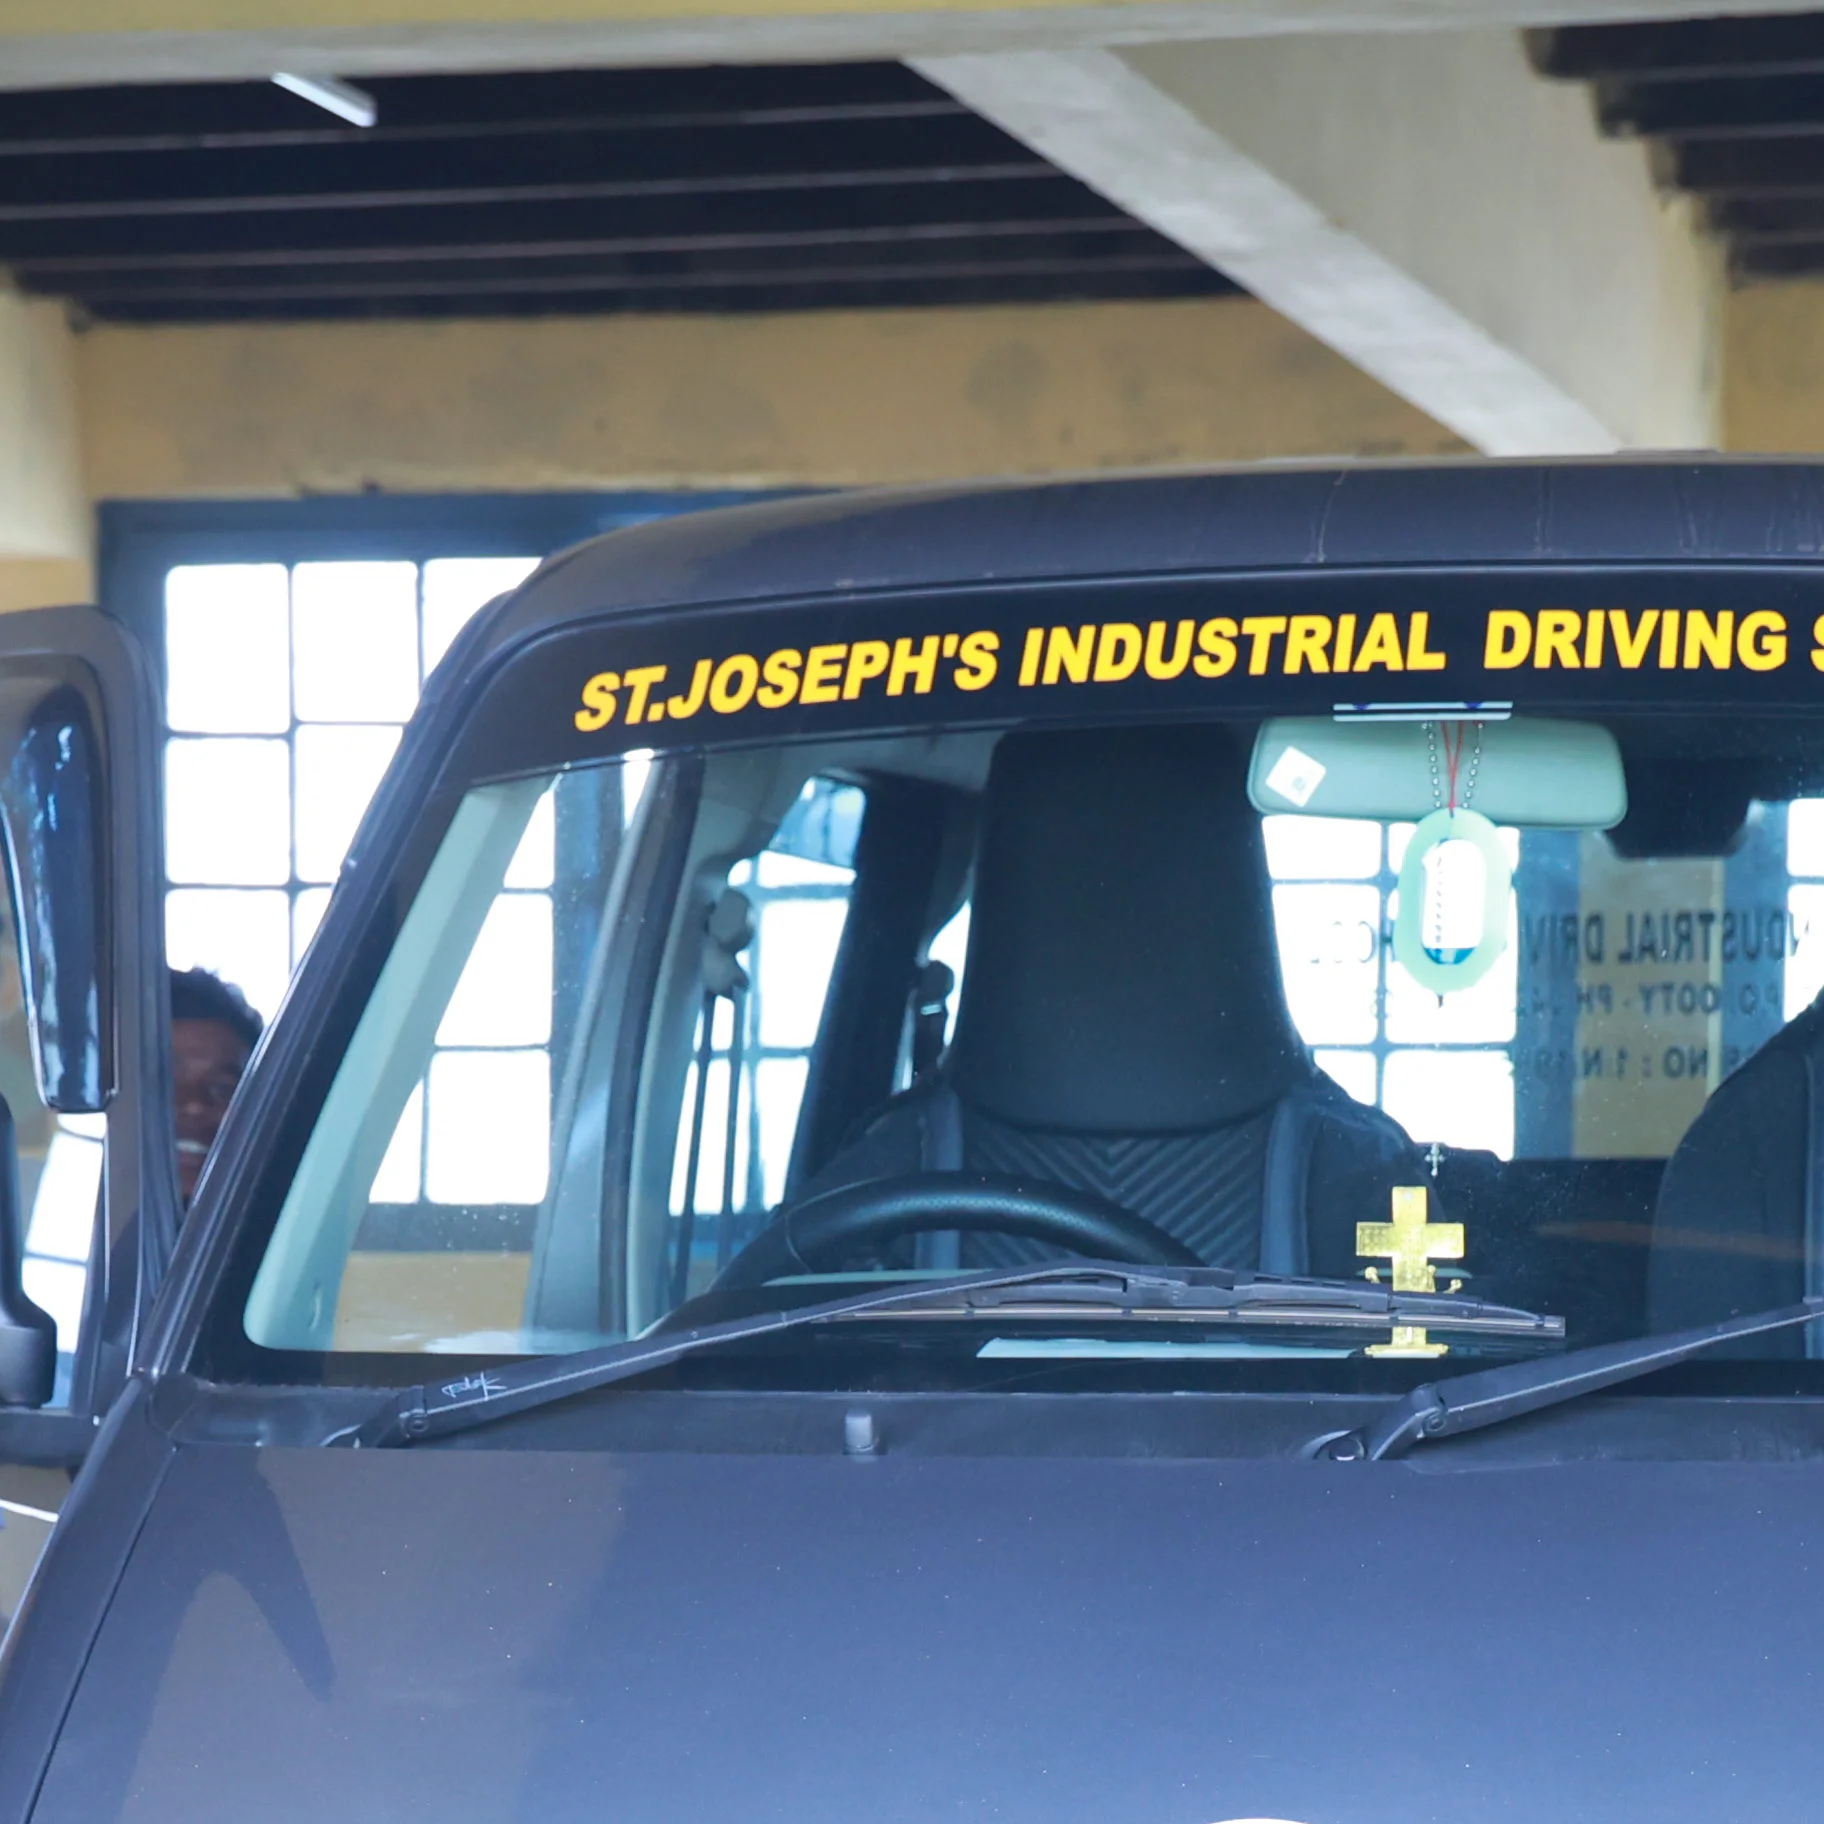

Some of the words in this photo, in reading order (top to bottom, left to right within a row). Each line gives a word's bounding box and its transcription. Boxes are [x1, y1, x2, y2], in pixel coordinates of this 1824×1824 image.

[573, 629, 1001, 732] ST.JOSEPH'S
[1017, 610, 1448, 688] INDUSTRIAL
[1482, 608, 1788, 672] DRIVING
